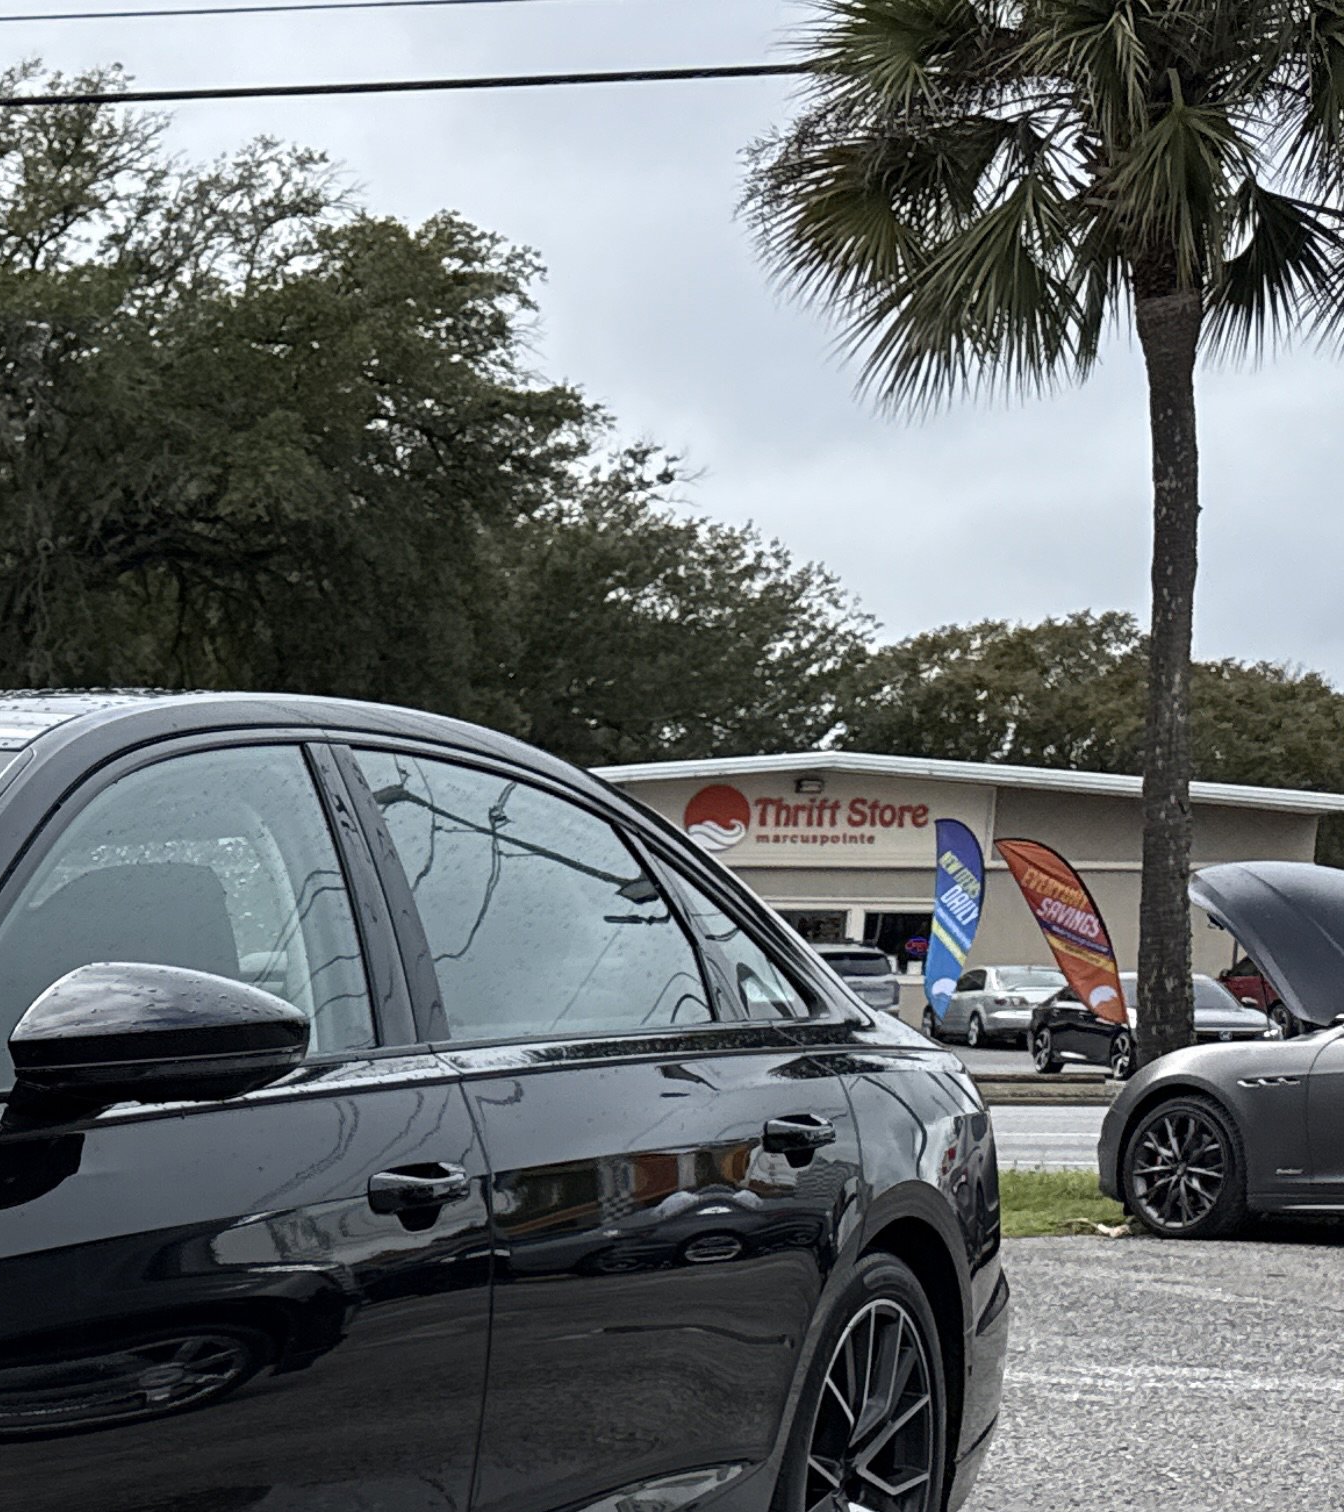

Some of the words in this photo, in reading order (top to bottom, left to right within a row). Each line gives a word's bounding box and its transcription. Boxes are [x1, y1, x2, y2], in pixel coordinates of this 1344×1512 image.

[755, 797, 841, 827] Thrift
[847, 797, 929, 828] Store
[756, 833, 875, 845] marcuspointe
[940, 885, 979, 926] DAILY
[1036, 897, 1101, 938] SAVINGS
